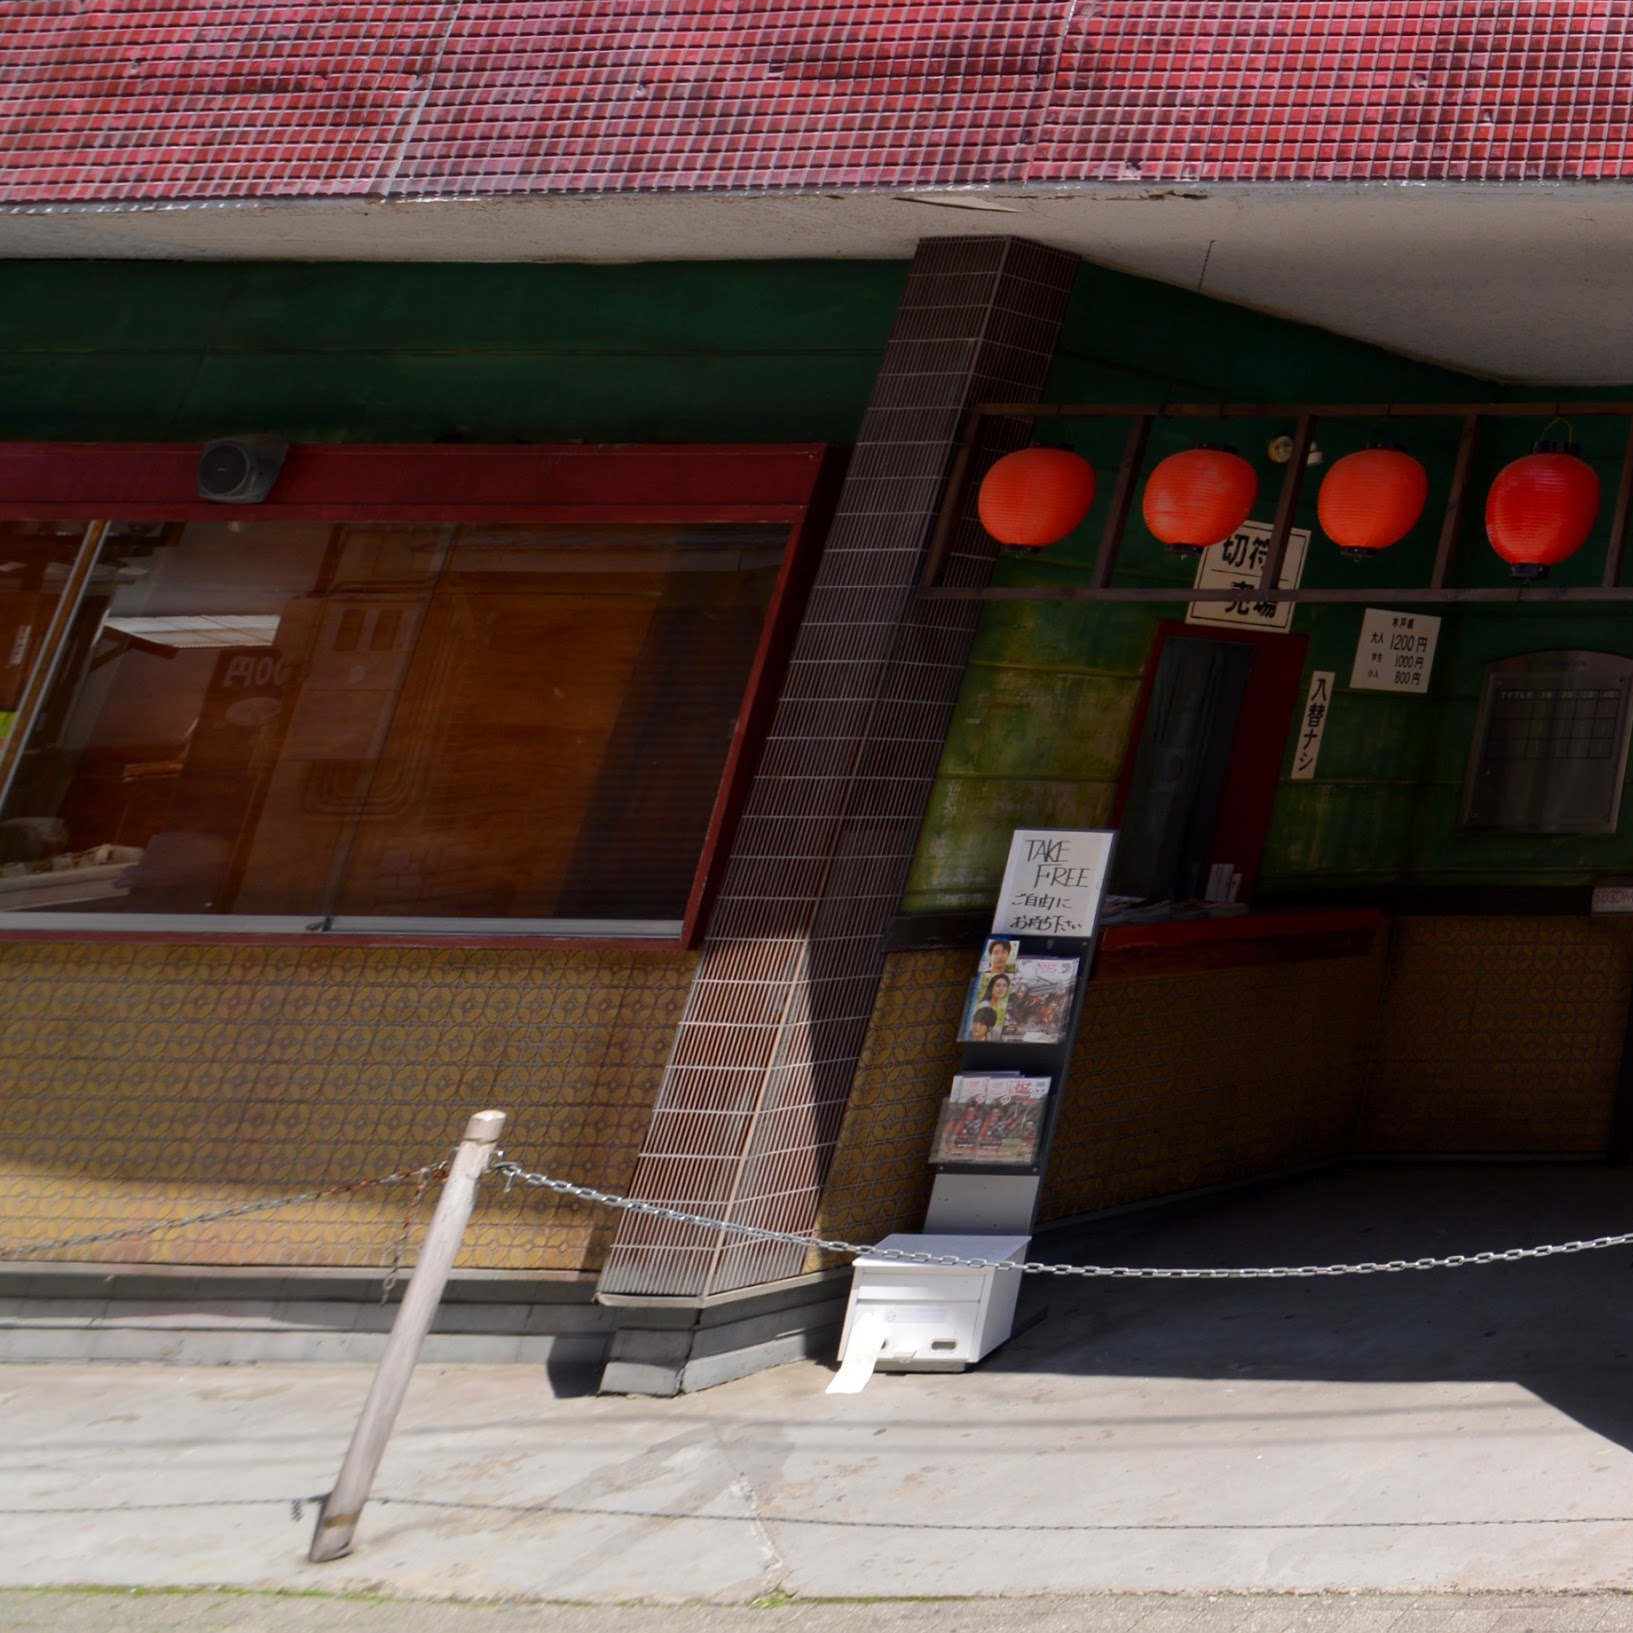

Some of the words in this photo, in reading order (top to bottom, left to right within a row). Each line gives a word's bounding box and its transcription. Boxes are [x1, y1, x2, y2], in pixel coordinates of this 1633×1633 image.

[1298, 678, 1327, 772] 入替ナシ
[1025, 839, 1072, 863] TAKE
[1033, 863, 1092, 889] FREE
[1011, 893, 1073, 911] ご自由に
[1009, 914, 1083, 934] お持ち下さい
